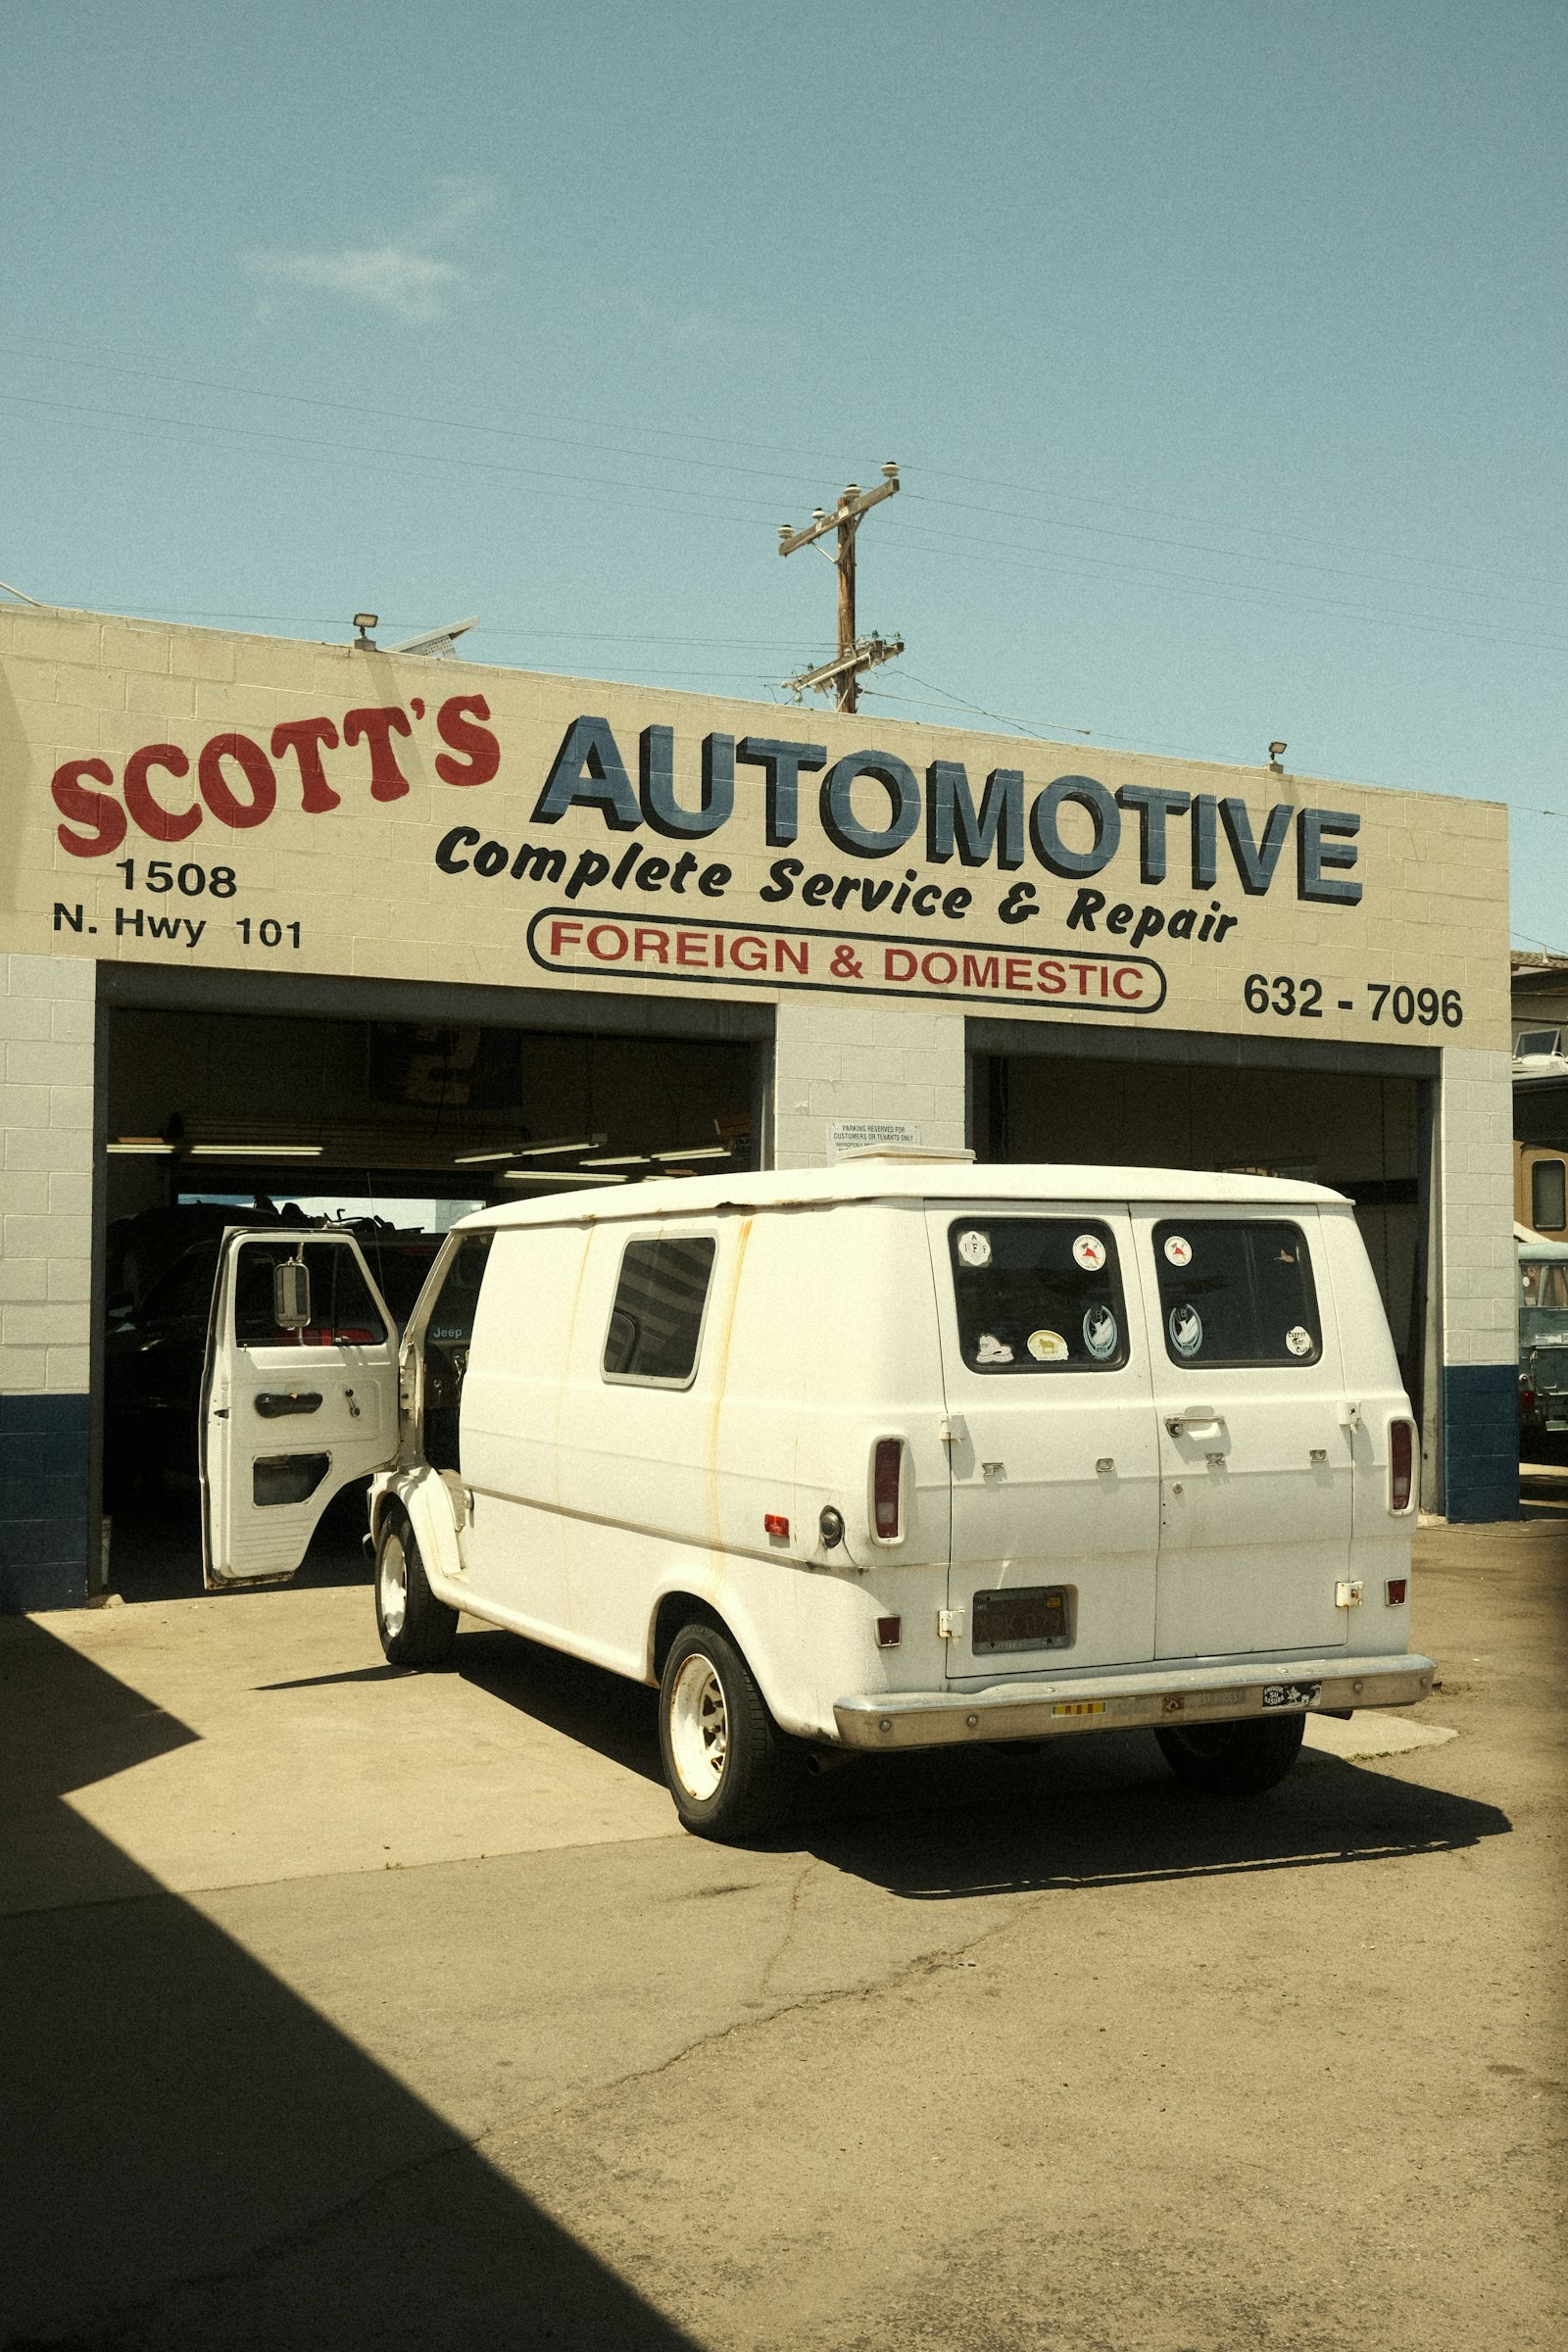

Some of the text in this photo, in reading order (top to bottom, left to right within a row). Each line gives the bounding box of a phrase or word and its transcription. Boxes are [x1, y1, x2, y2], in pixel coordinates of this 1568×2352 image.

[51, 694, 1363, 906] SCOTT'S AUTOMOTIVE
[116, 858, 237, 899] 1508
[435, 826, 1239, 949] Complete Service & Repair
[53, 903, 302, 949] N. Hwy 101
[550, 921, 1145, 1001] FOREIGN & DOMESTIC
[1244, 973, 1323, 1018] 632
[1367, 983, 1463, 1028] 7096
[433, 1326, 463, 1340] Jeep
